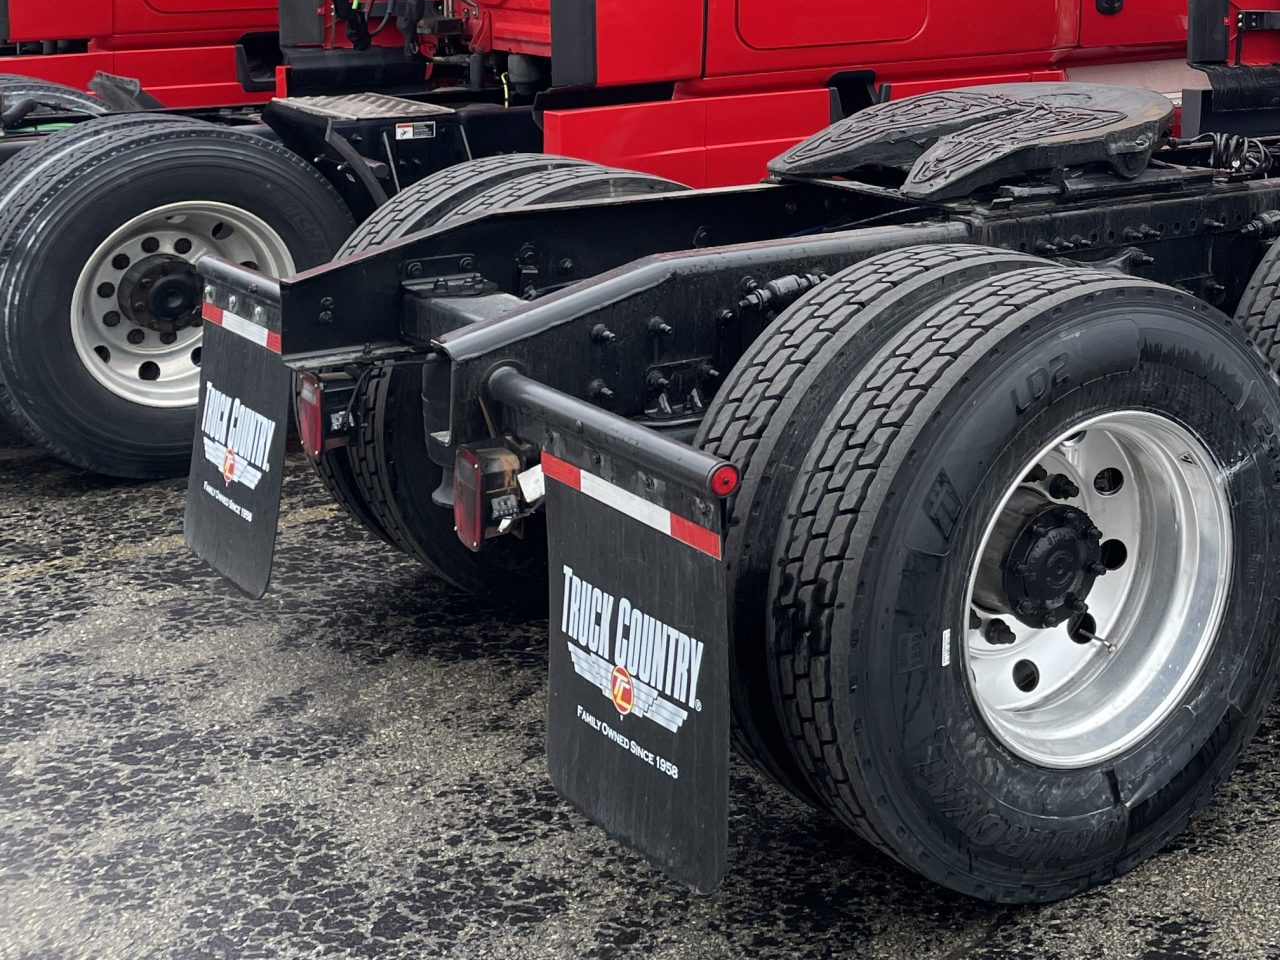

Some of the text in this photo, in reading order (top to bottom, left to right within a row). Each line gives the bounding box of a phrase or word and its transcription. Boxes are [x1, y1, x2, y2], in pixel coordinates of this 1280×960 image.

[201, 380, 276, 472] TRUCK COUNTRY
[561, 564, 705, 709] TRUCK COUNTRY
[577, 704, 679, 780] FAMILY OWNED SINCE 1958
